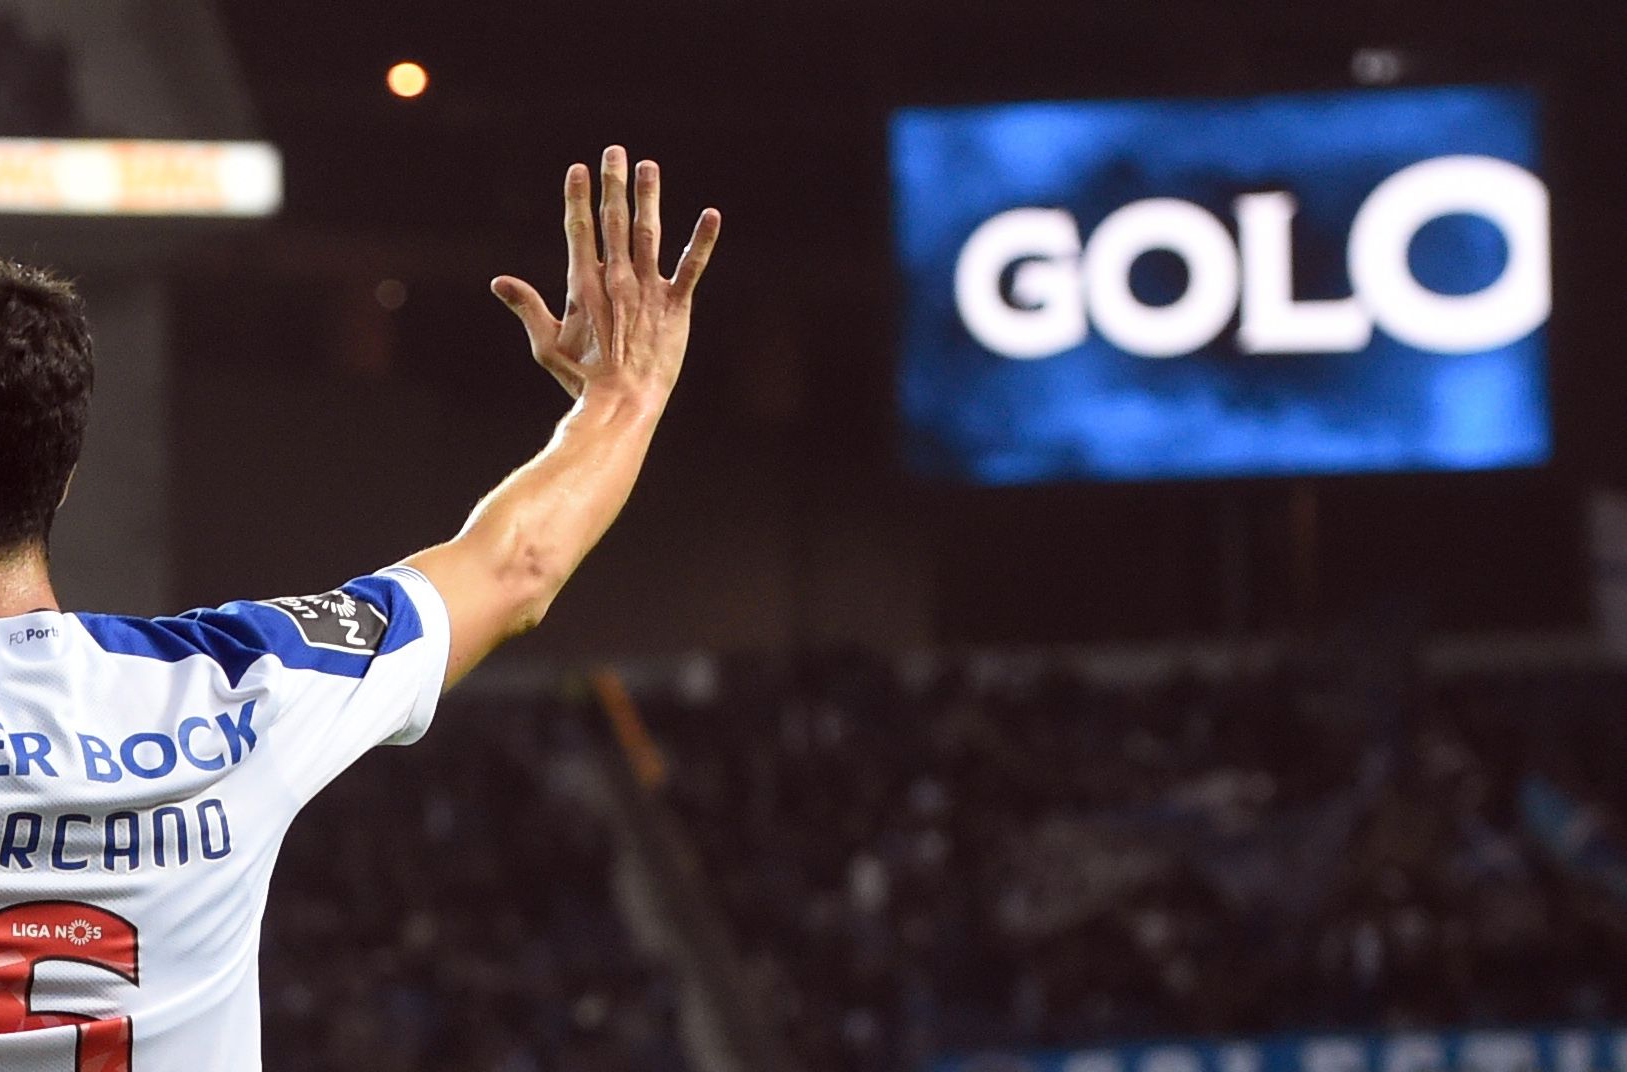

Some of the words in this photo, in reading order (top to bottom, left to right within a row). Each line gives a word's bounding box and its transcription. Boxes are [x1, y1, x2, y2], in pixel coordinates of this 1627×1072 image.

[954, 154, 1553, 360] GOLO
[76, 699, 257, 783] BOCK
[12, 922, 50, 939] LIGA
[54, 919, 102, 946] NOS
